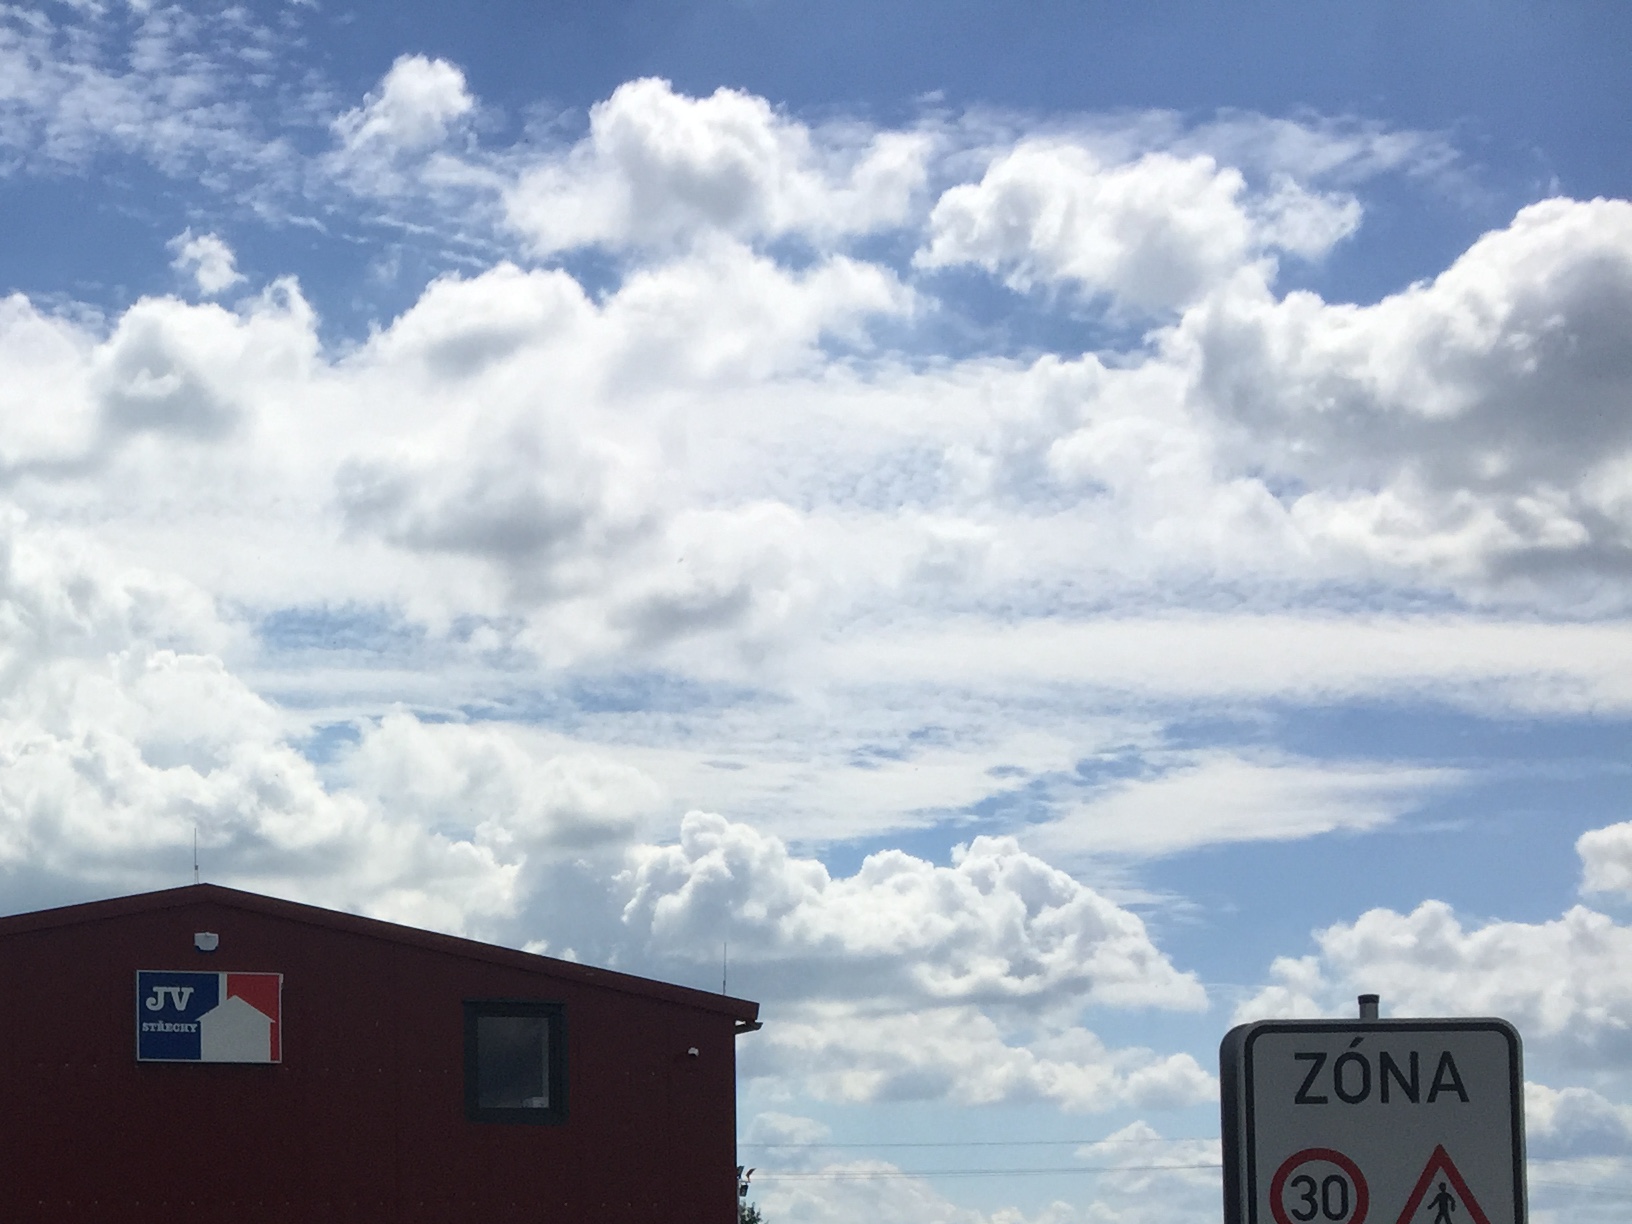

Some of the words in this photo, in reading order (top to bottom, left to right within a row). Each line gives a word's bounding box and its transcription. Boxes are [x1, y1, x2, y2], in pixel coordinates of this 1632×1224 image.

[145, 986, 195, 1012] JV
[141, 1020, 198, 1033] STŘECHY
[1293, 1036, 1471, 1105] ZÓNA
[1289, 1174, 1350, 1222] 30
